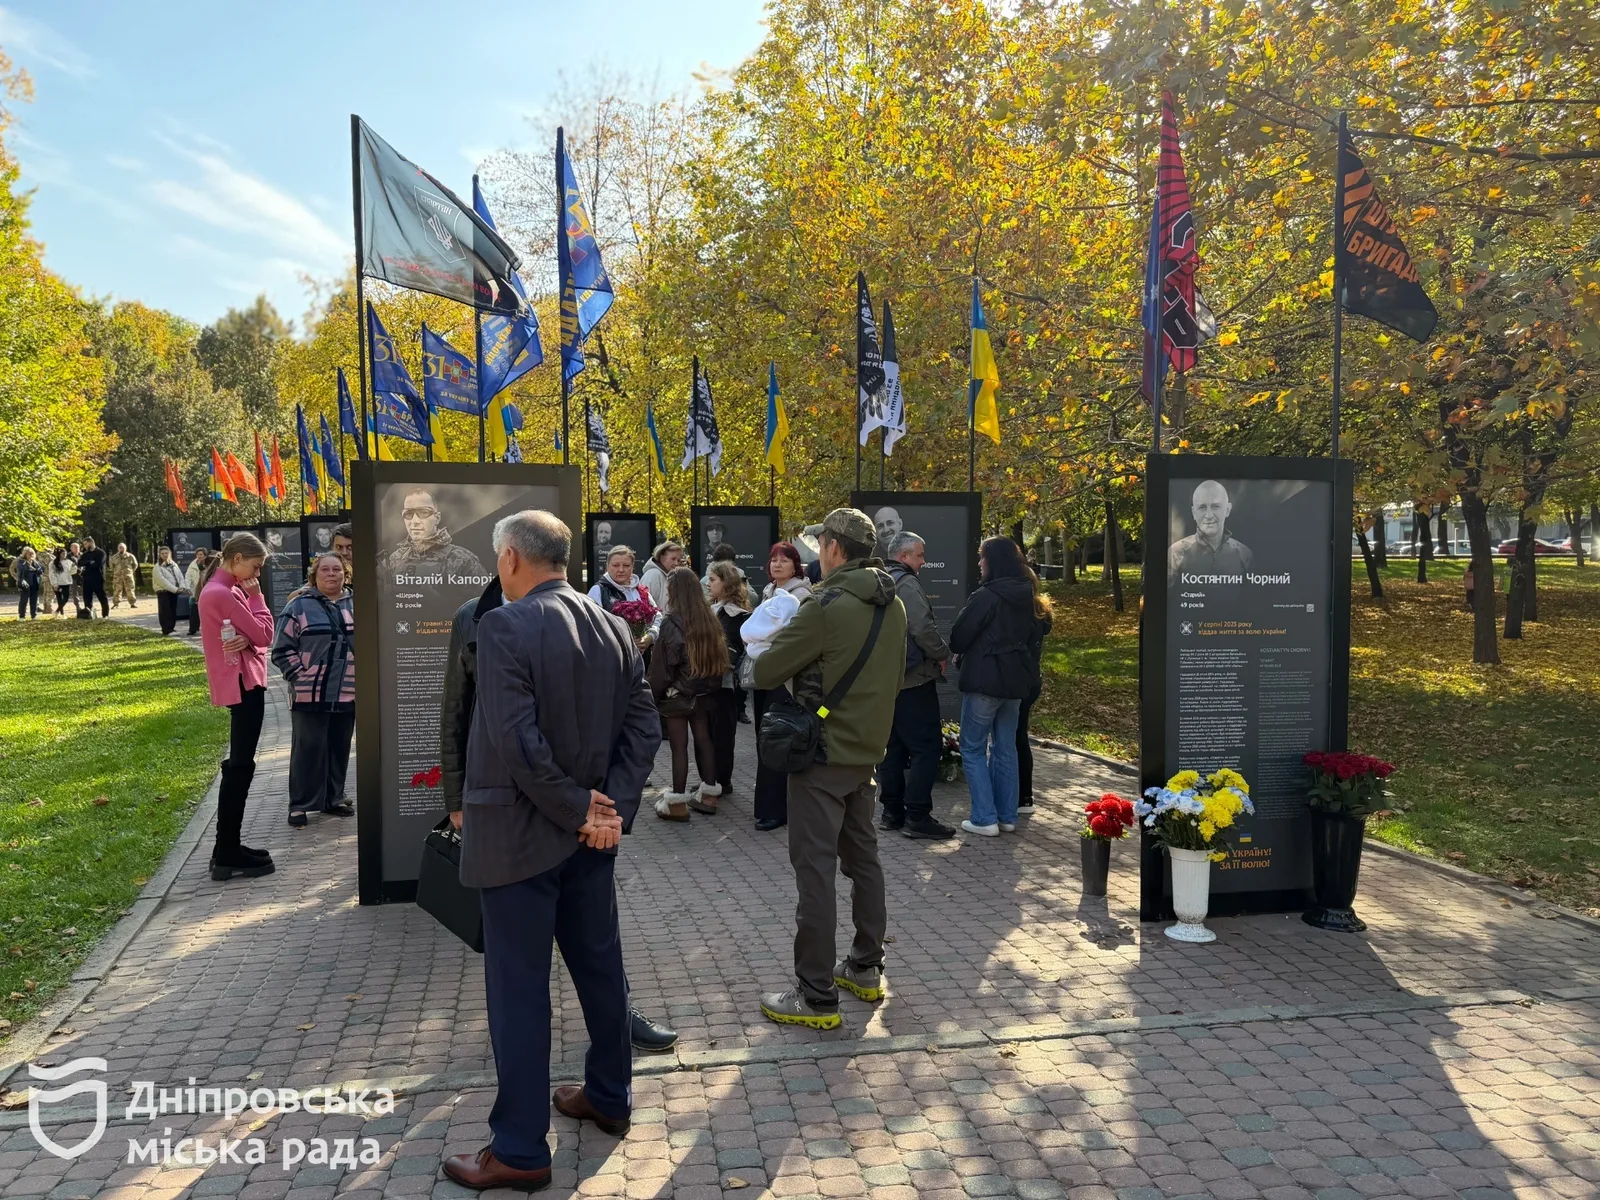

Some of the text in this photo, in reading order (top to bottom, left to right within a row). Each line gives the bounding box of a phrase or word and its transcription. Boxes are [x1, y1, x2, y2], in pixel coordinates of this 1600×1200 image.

[423, 351, 447, 381] 31
[396, 573, 495, 587] Віталій Капорі
[1181, 572, 1291, 586] Костянтин Чорний
[1204, 621, 1222, 629] серпні
[1262, 627, 1287, 636] України!
[1232, 847, 1272, 858] УКРАЇНУ!
[1219, 859, 1270, 870] ЗА ЇЇ ВОЛЮ!
